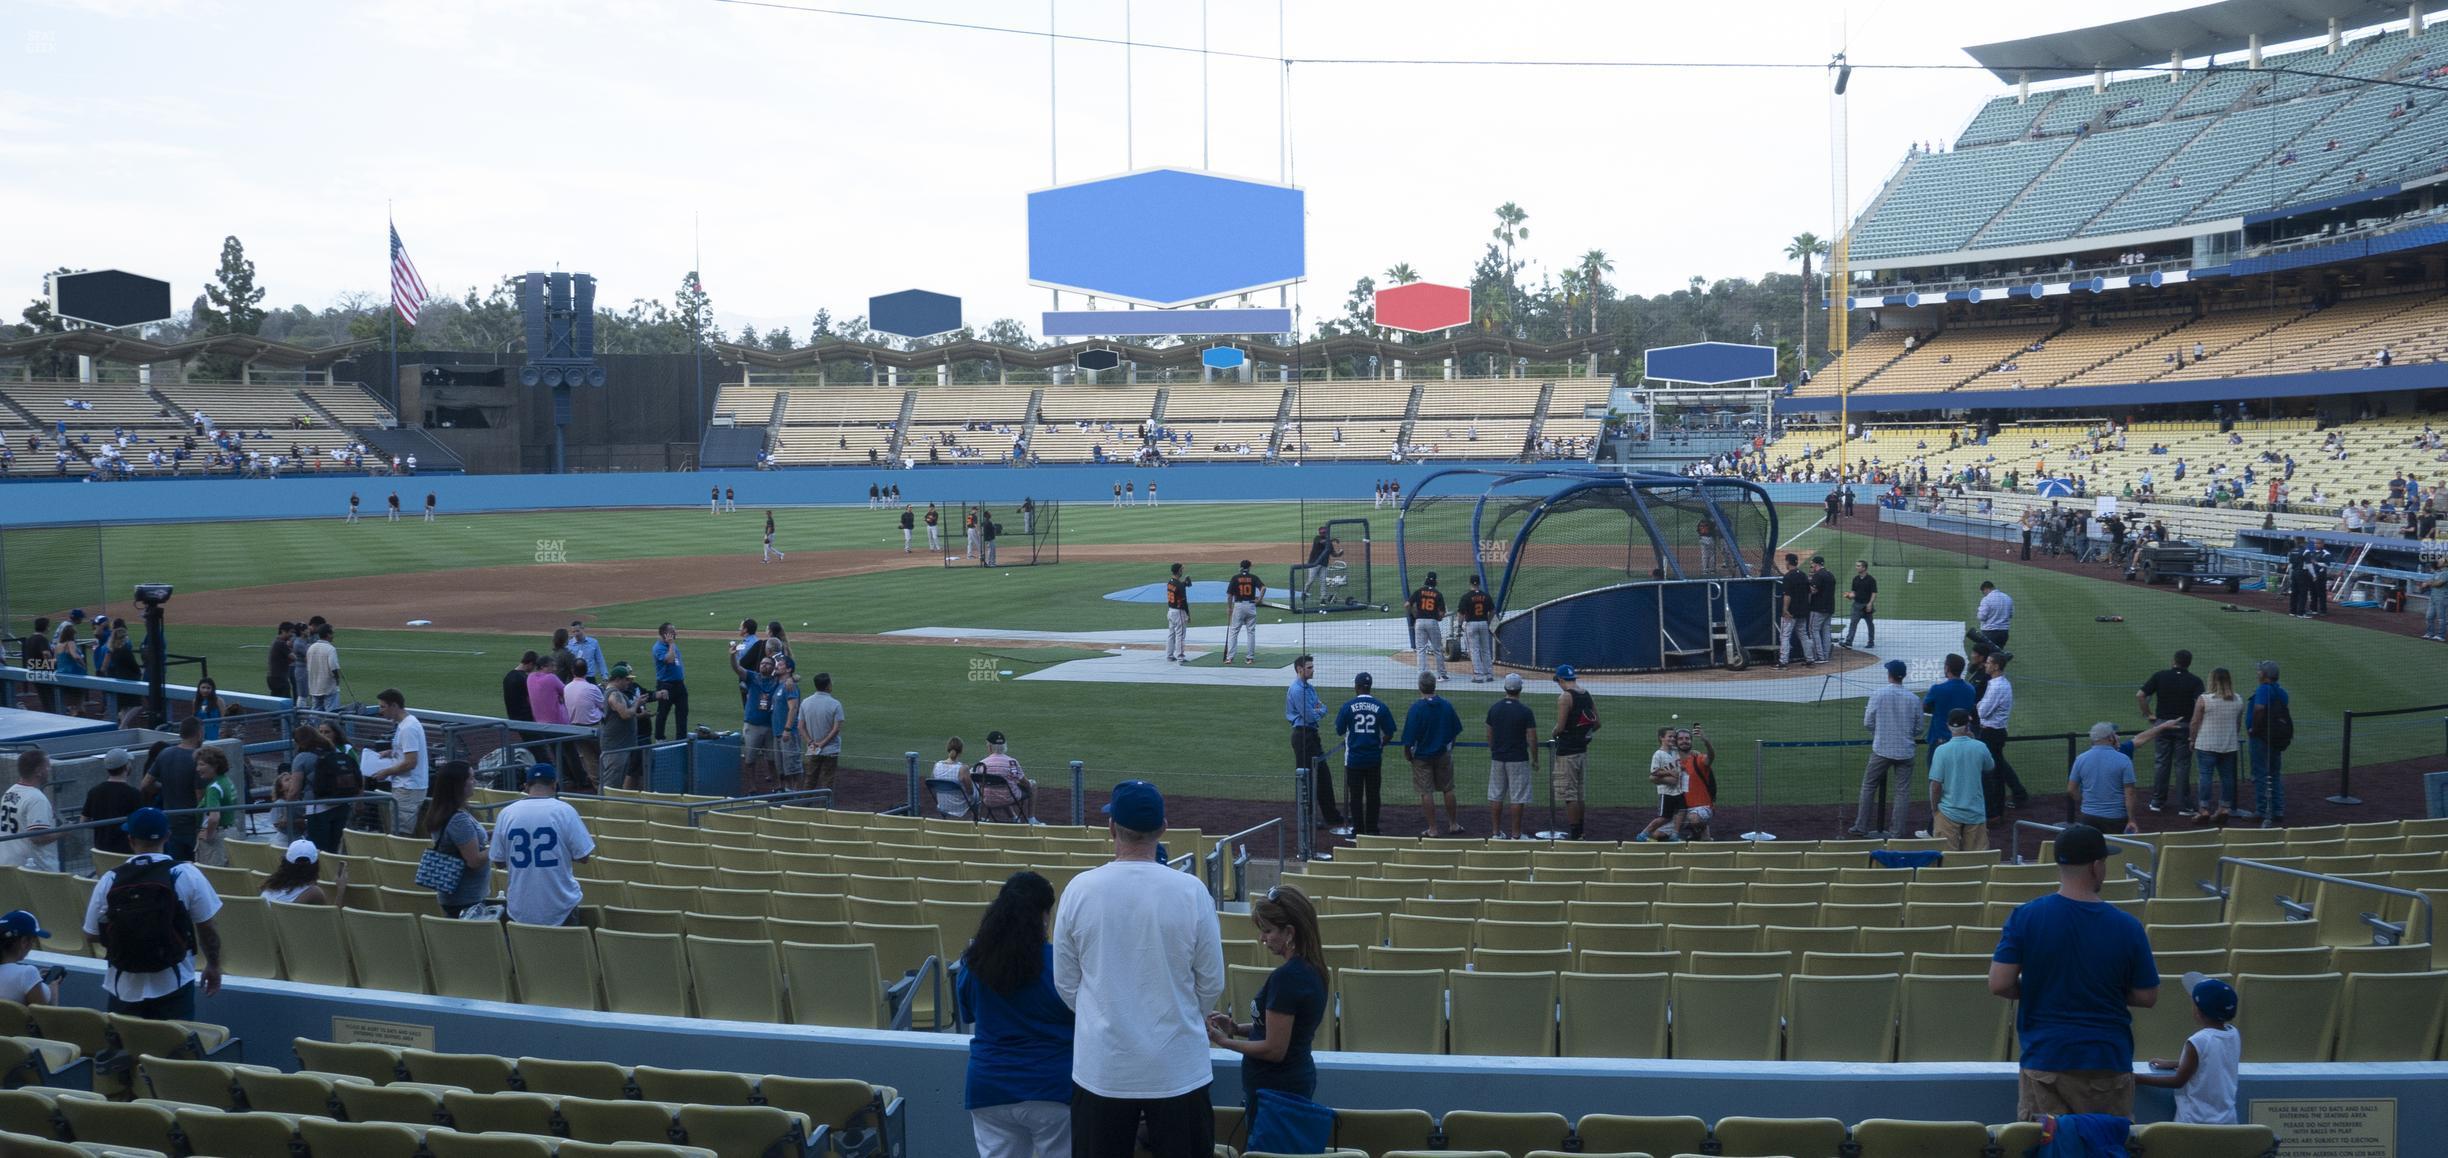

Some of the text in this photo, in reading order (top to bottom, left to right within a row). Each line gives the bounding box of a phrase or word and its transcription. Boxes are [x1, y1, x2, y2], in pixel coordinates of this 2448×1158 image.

[1238, 584, 1252, 596] 10
[1420, 598, 1435, 610] 16
[1474, 603, 1485, 616] 2
[1354, 714, 1376, 733] 22
[1, 805, 19, 834] 25
[507, 826, 559, 869] 32
